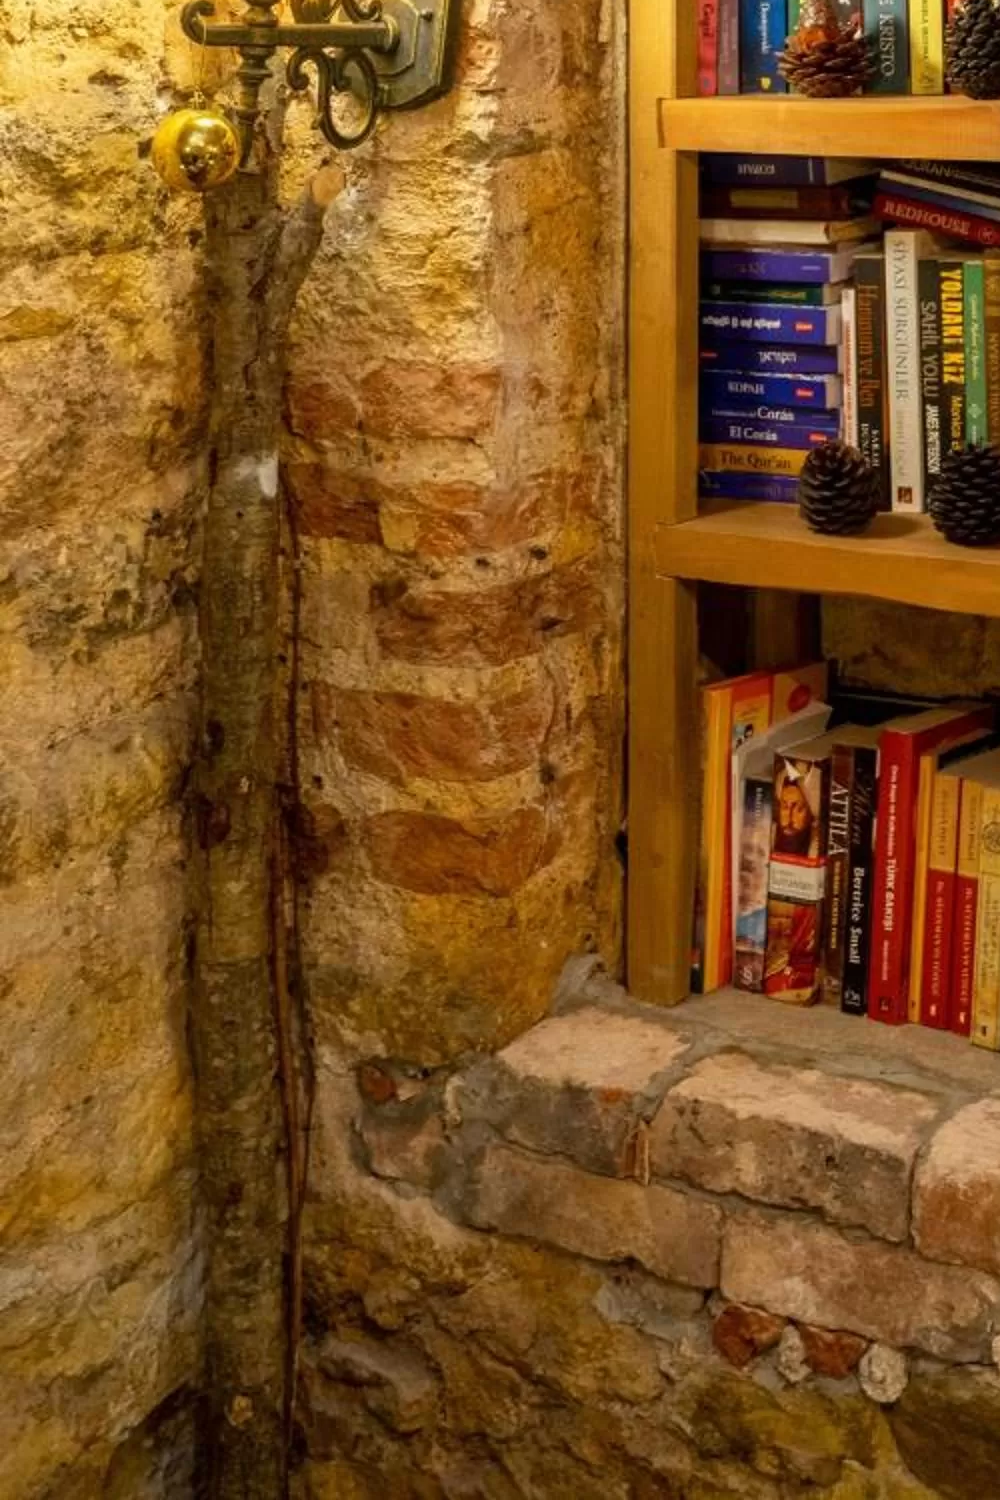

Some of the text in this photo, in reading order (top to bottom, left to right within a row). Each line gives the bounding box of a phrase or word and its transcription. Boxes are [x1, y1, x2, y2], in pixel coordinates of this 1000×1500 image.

[879, 12, 895, 77] KRISTO
[883, 200, 971, 235] REDHOUSE
[920, 300, 941, 349] SAHİL
[923, 353, 938, 398] YOLU
[729, 425, 742, 438] El
[925, 403, 939, 431] JAMES
[720, 450, 743, 466] The
[828, 780, 849, 856] ATTILA
[886, 857, 897, 890] TÜRK
[848, 866, 865, 965] Bertrice Small
